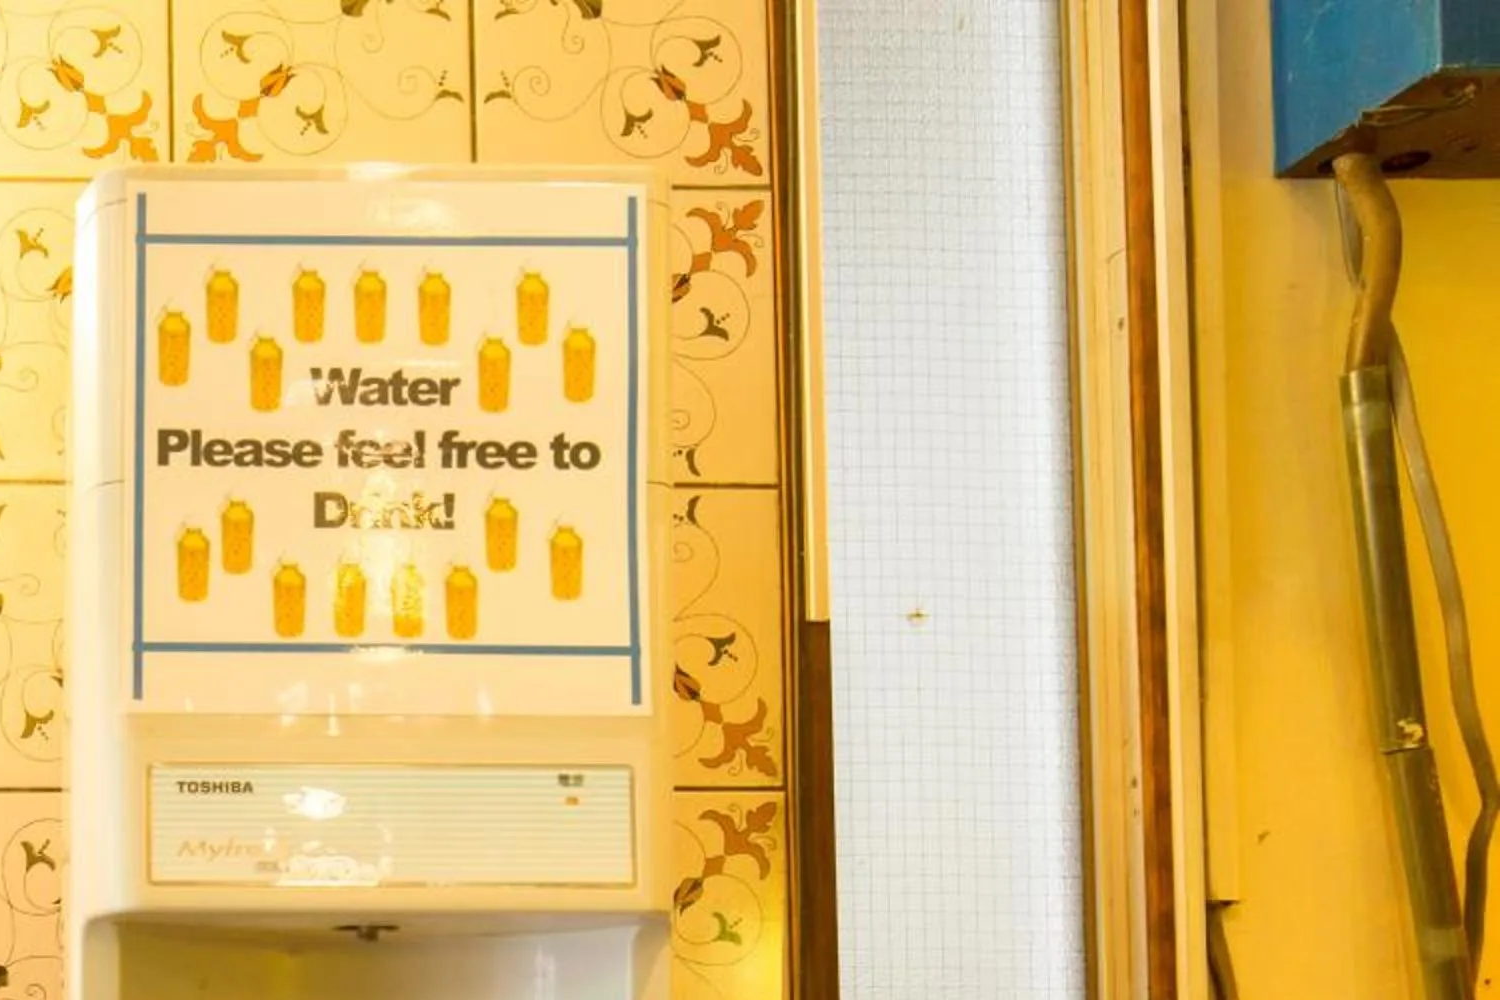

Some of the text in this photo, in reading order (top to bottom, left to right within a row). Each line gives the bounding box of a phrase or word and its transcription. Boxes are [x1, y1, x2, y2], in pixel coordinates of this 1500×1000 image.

[309, 367, 461, 407] Water
[157, 428, 601, 471] Please feel free to
[176, 780, 254, 794] TOSHIBA
